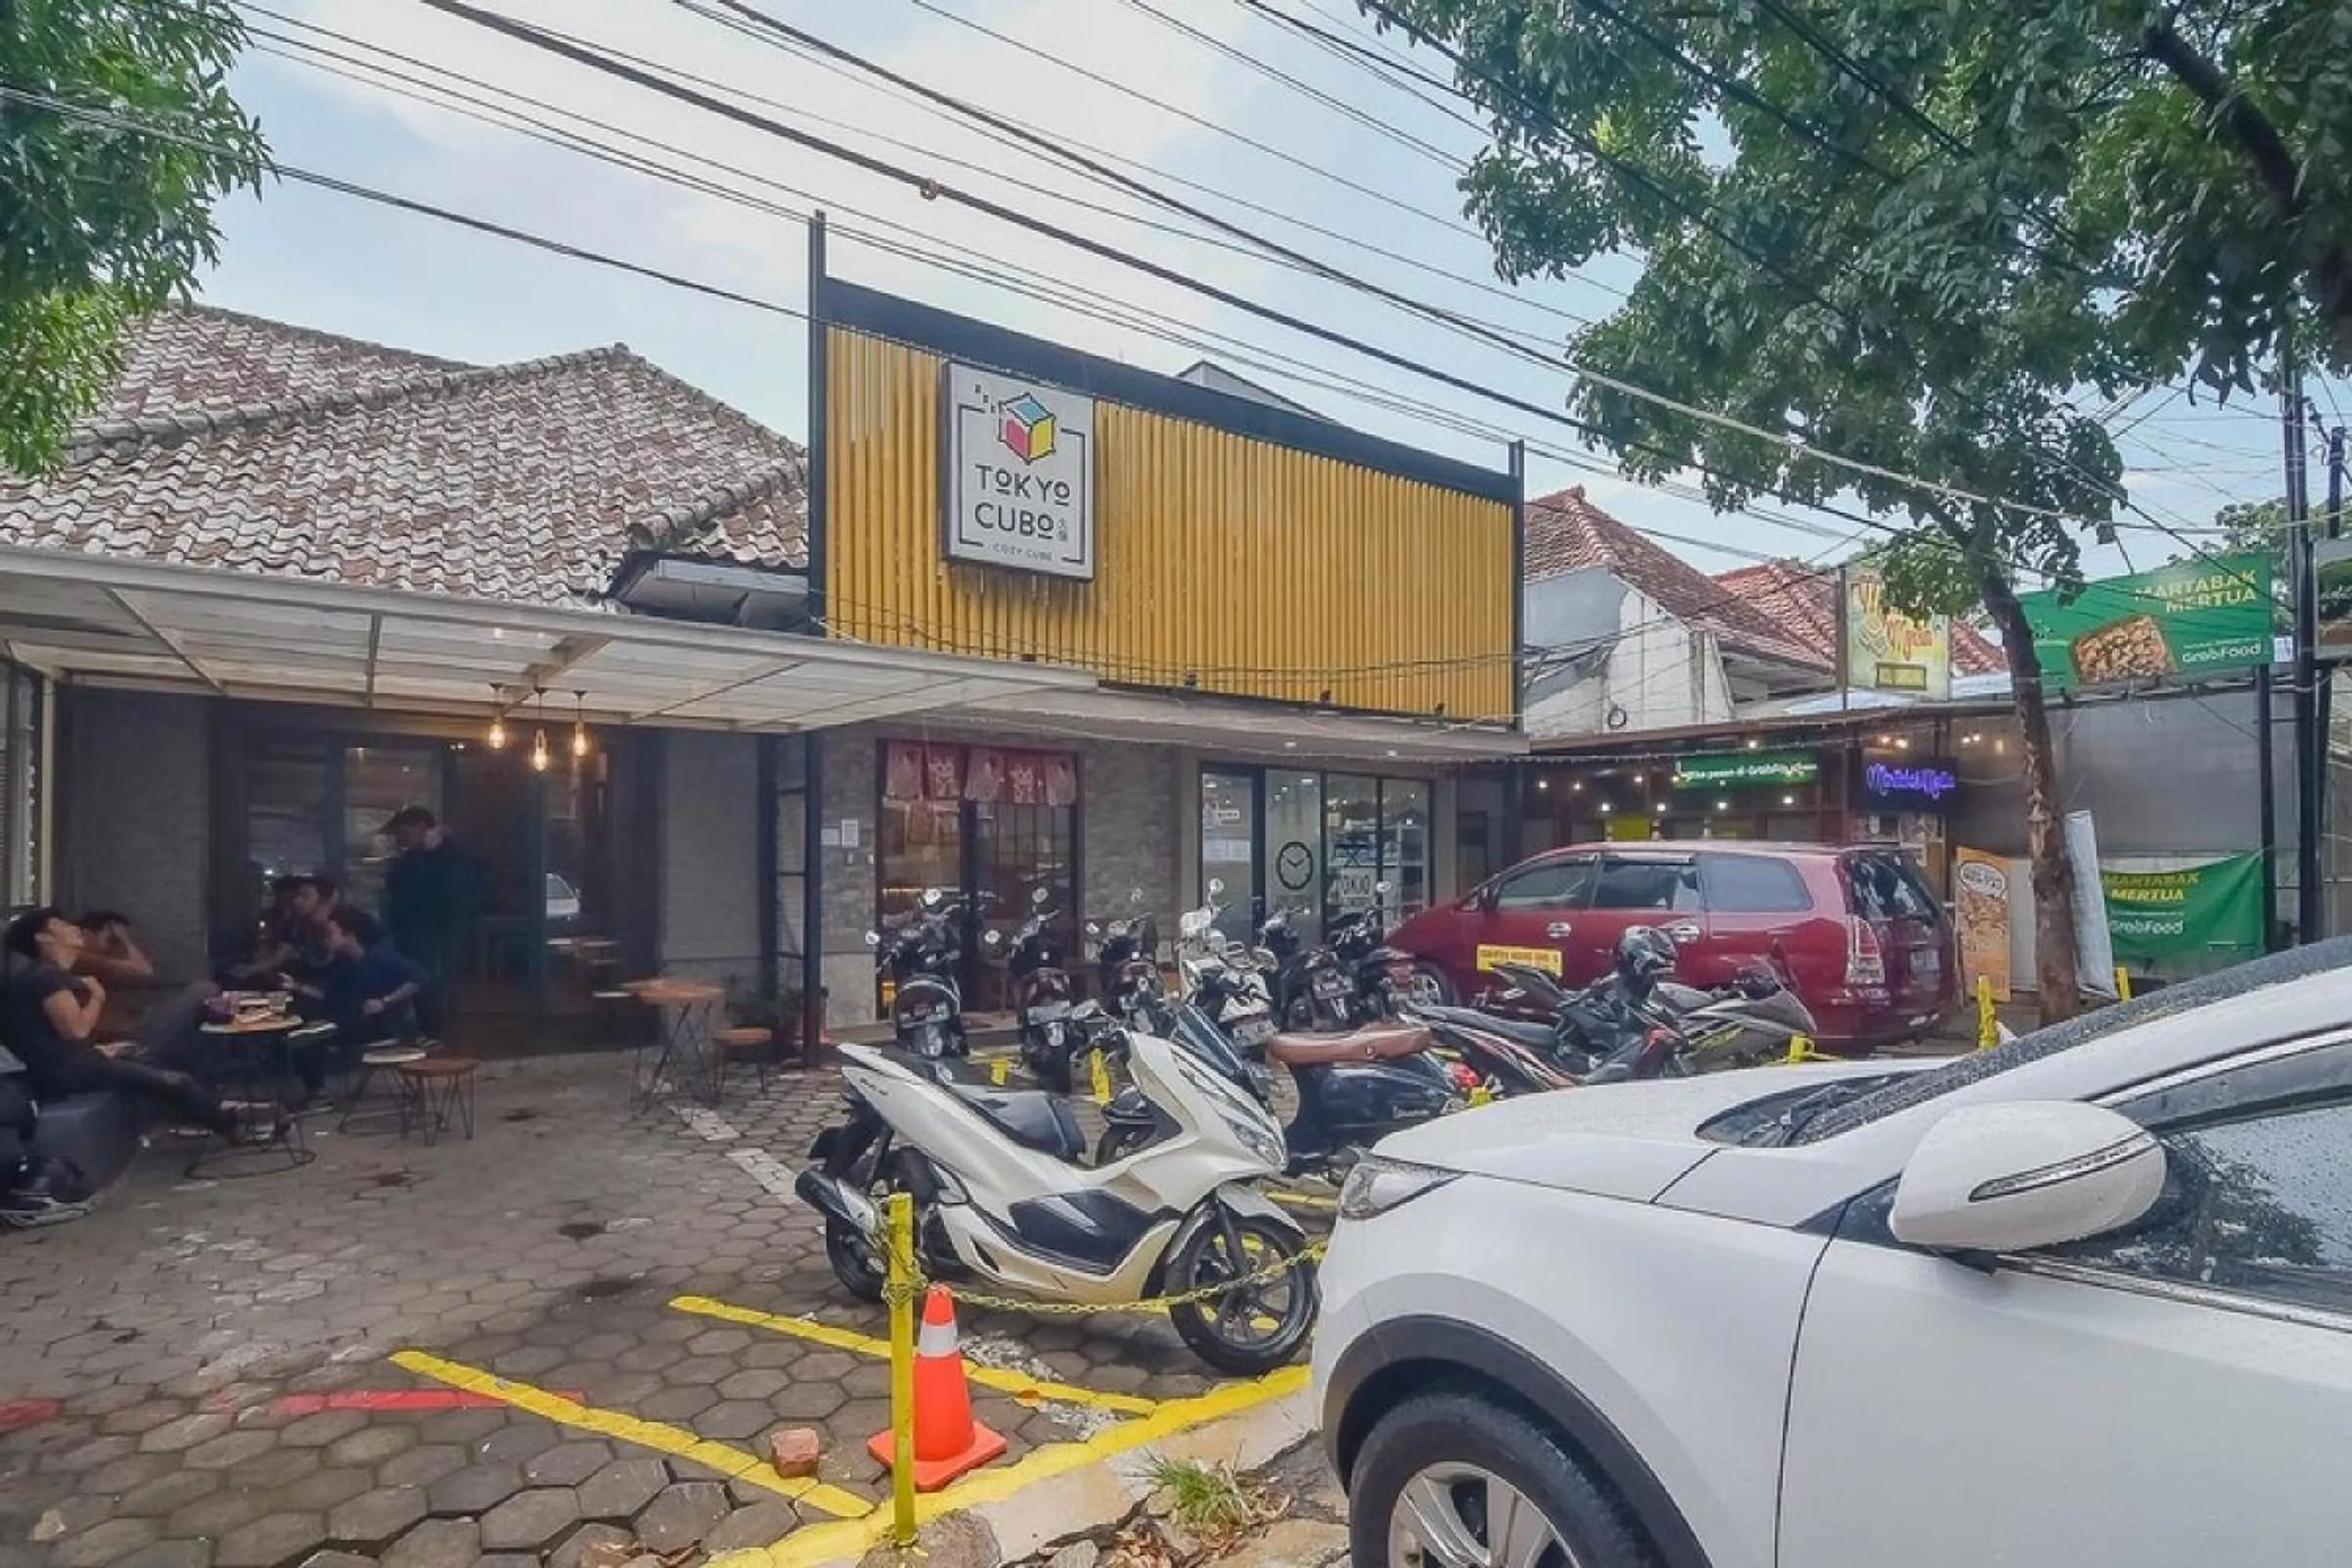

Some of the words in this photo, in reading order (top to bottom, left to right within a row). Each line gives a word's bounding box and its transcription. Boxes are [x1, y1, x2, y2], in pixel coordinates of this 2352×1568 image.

[975, 463, 1070, 506] TOKYO
[975, 503, 1054, 539] CUBO
[2182, 642, 2261, 663] GrabFood
[2111, 887, 2184, 902] MERTUA
